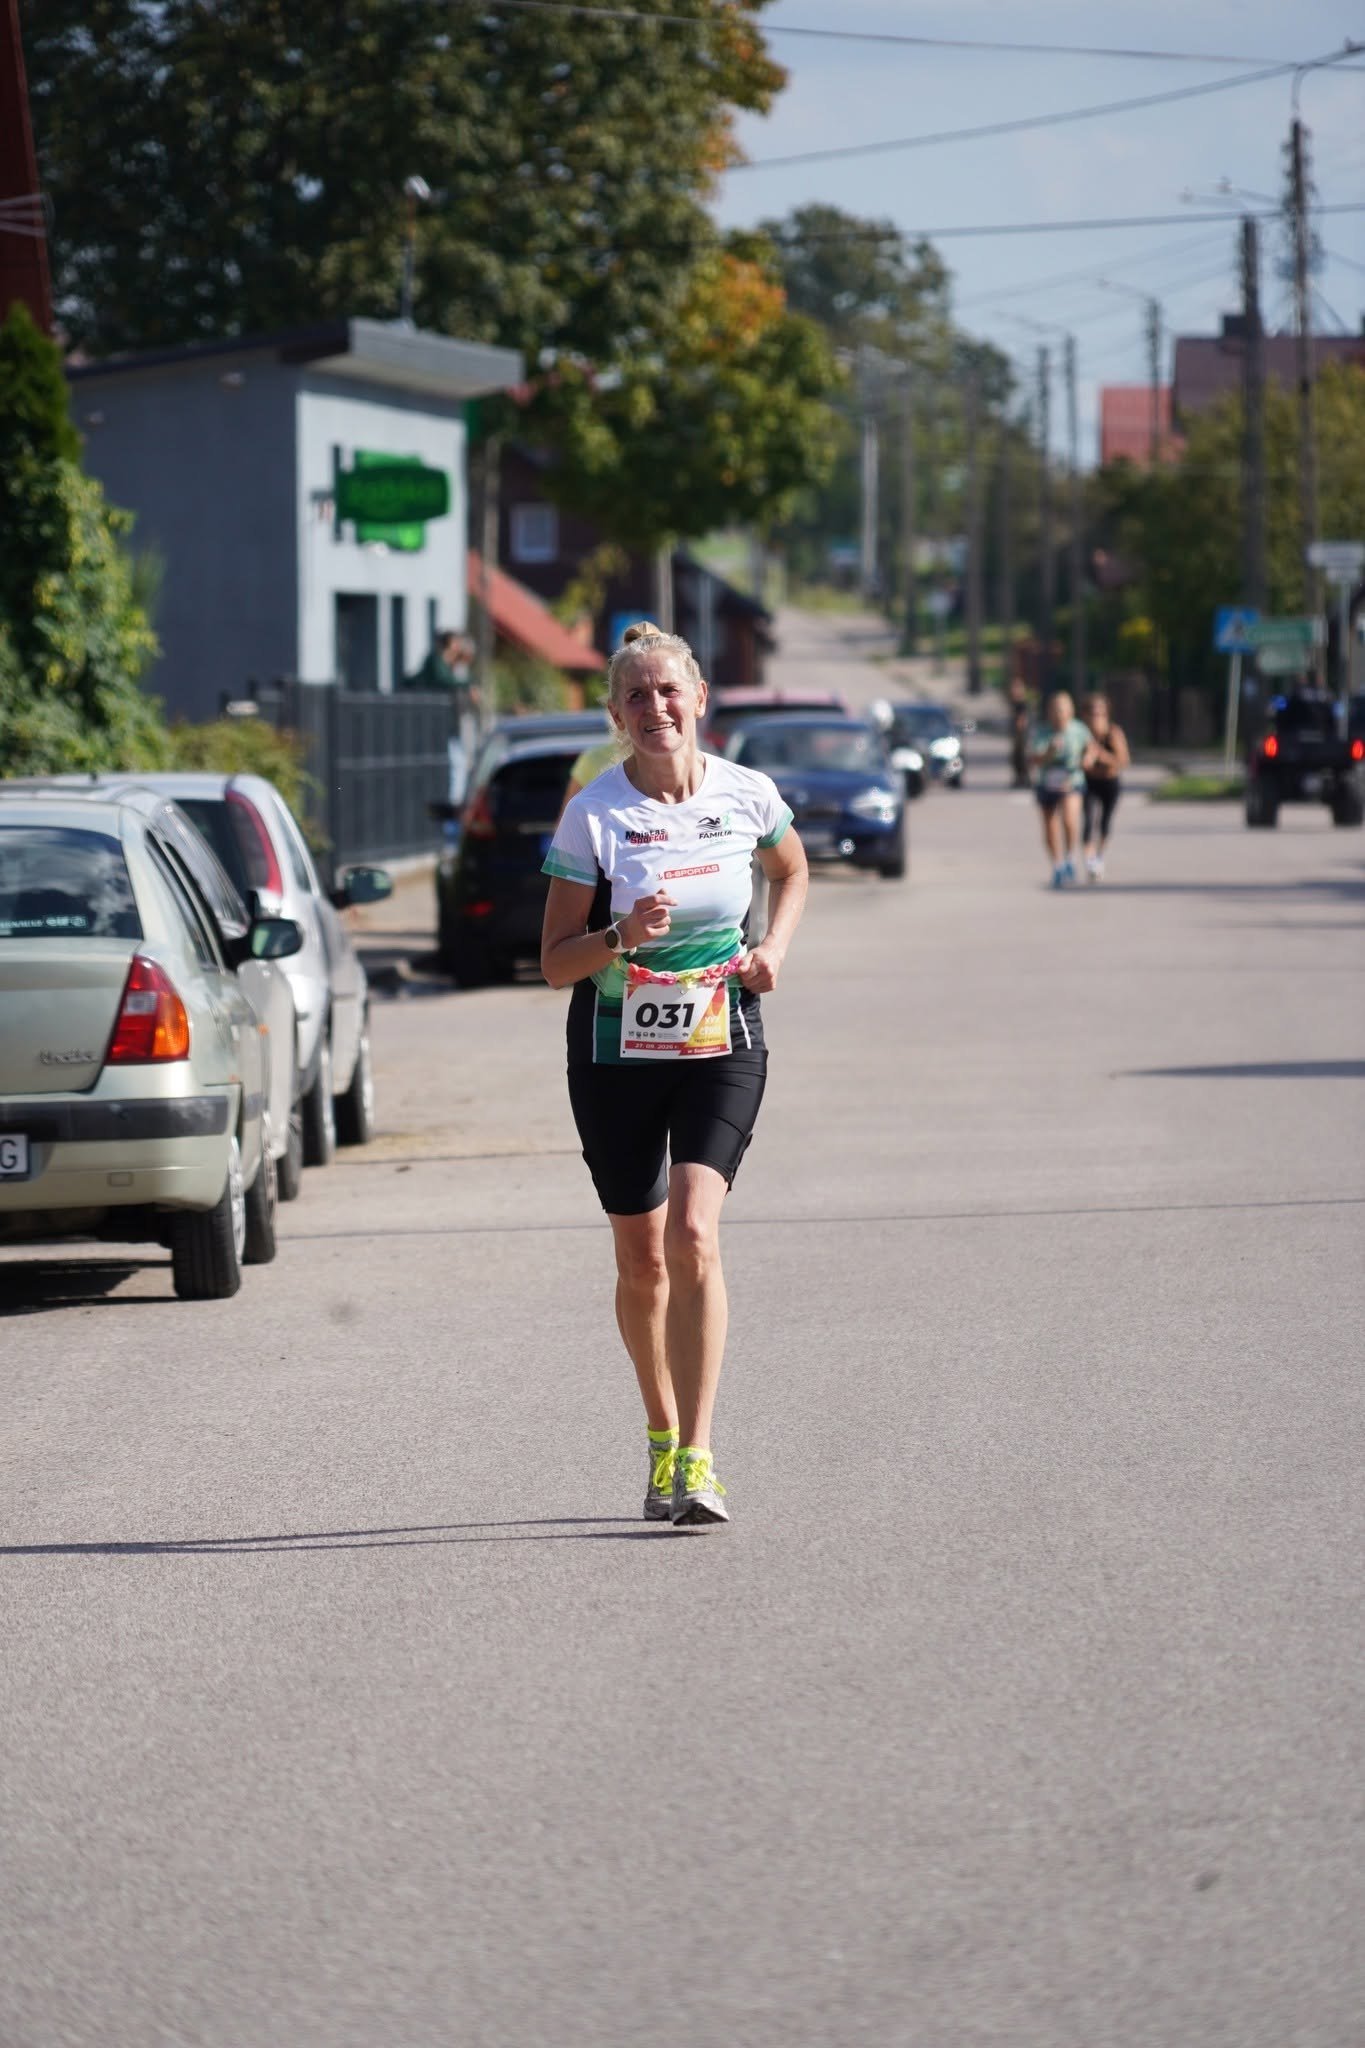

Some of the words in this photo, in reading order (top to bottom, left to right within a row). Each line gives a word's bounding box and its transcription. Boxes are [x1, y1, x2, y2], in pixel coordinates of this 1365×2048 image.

[698, 830, 732, 839] FAMILIA
[635, 1002, 695, 1029] 031
[0, 1140, 17, 1169] G
